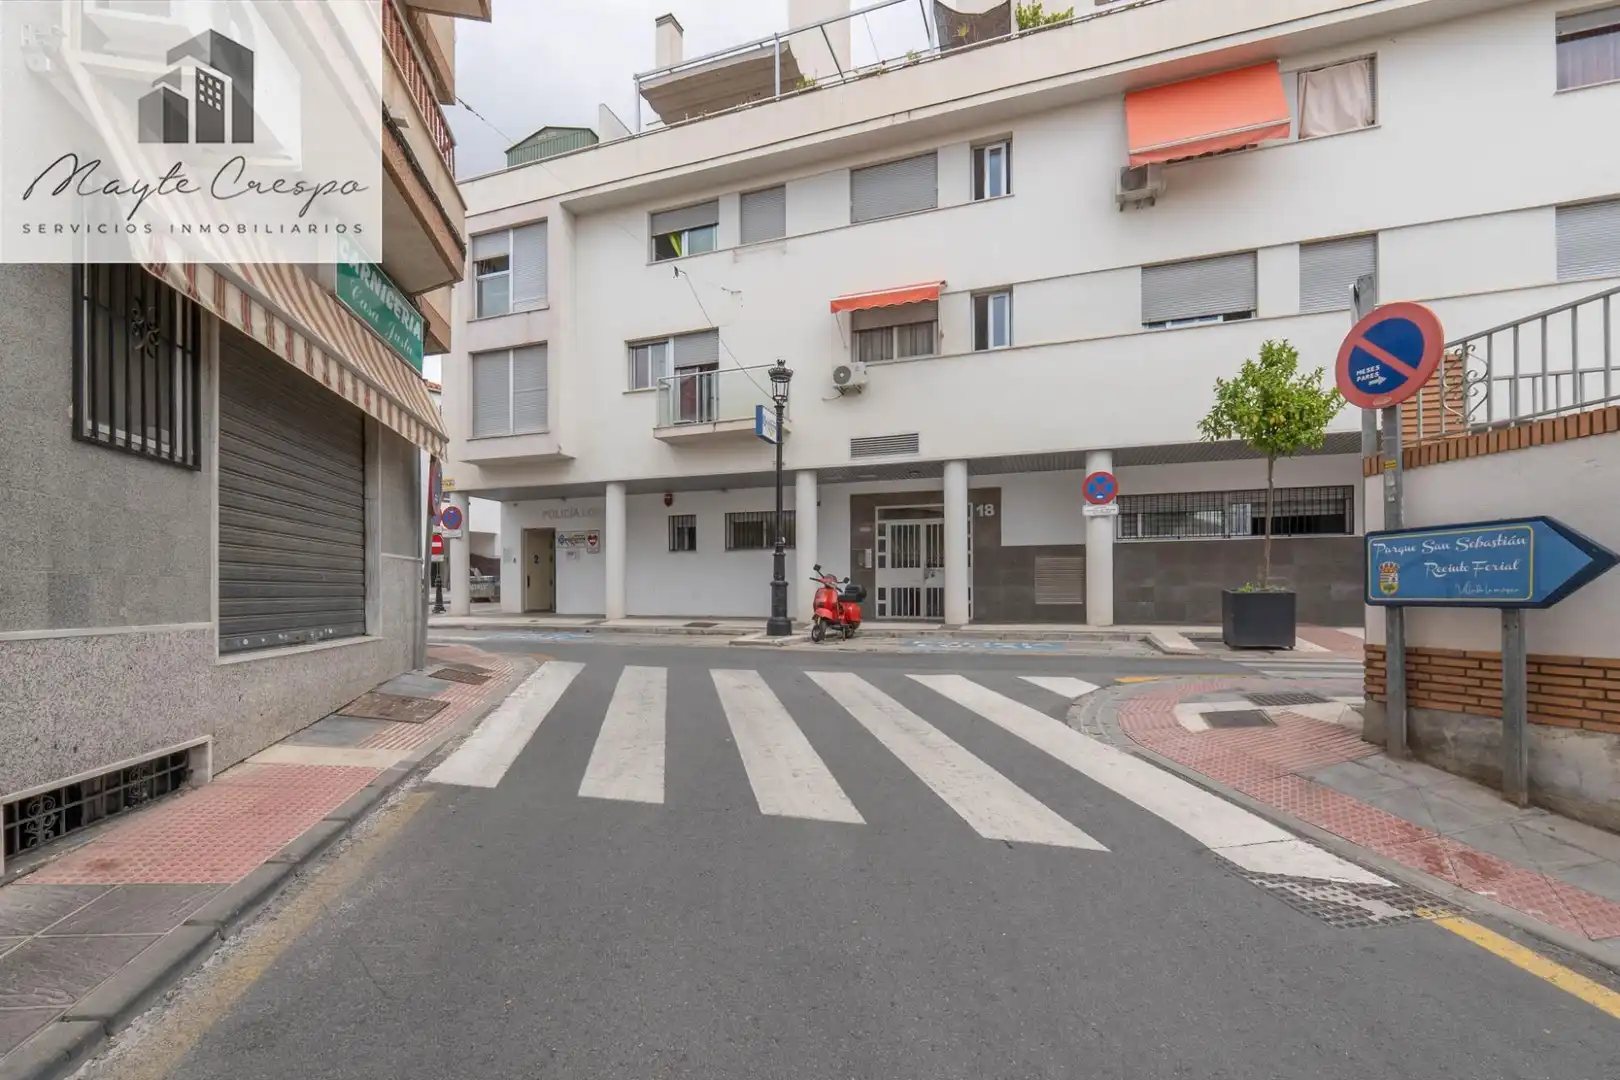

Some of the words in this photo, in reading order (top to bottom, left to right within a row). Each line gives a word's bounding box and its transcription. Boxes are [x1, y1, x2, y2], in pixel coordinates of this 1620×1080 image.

[1356, 364, 1380, 376] MESES
[1356, 371, 1380, 382] PARES
[976, 503, 995, 517] 18
[1373, 543, 1416, 559] Parque
[1421, 539, 1450, 554] San
[1456, 534, 1526, 551] Sebastián
[1424, 561, 1469, 578] Recinto
[1472, 559, 1520, 578] Ferial
